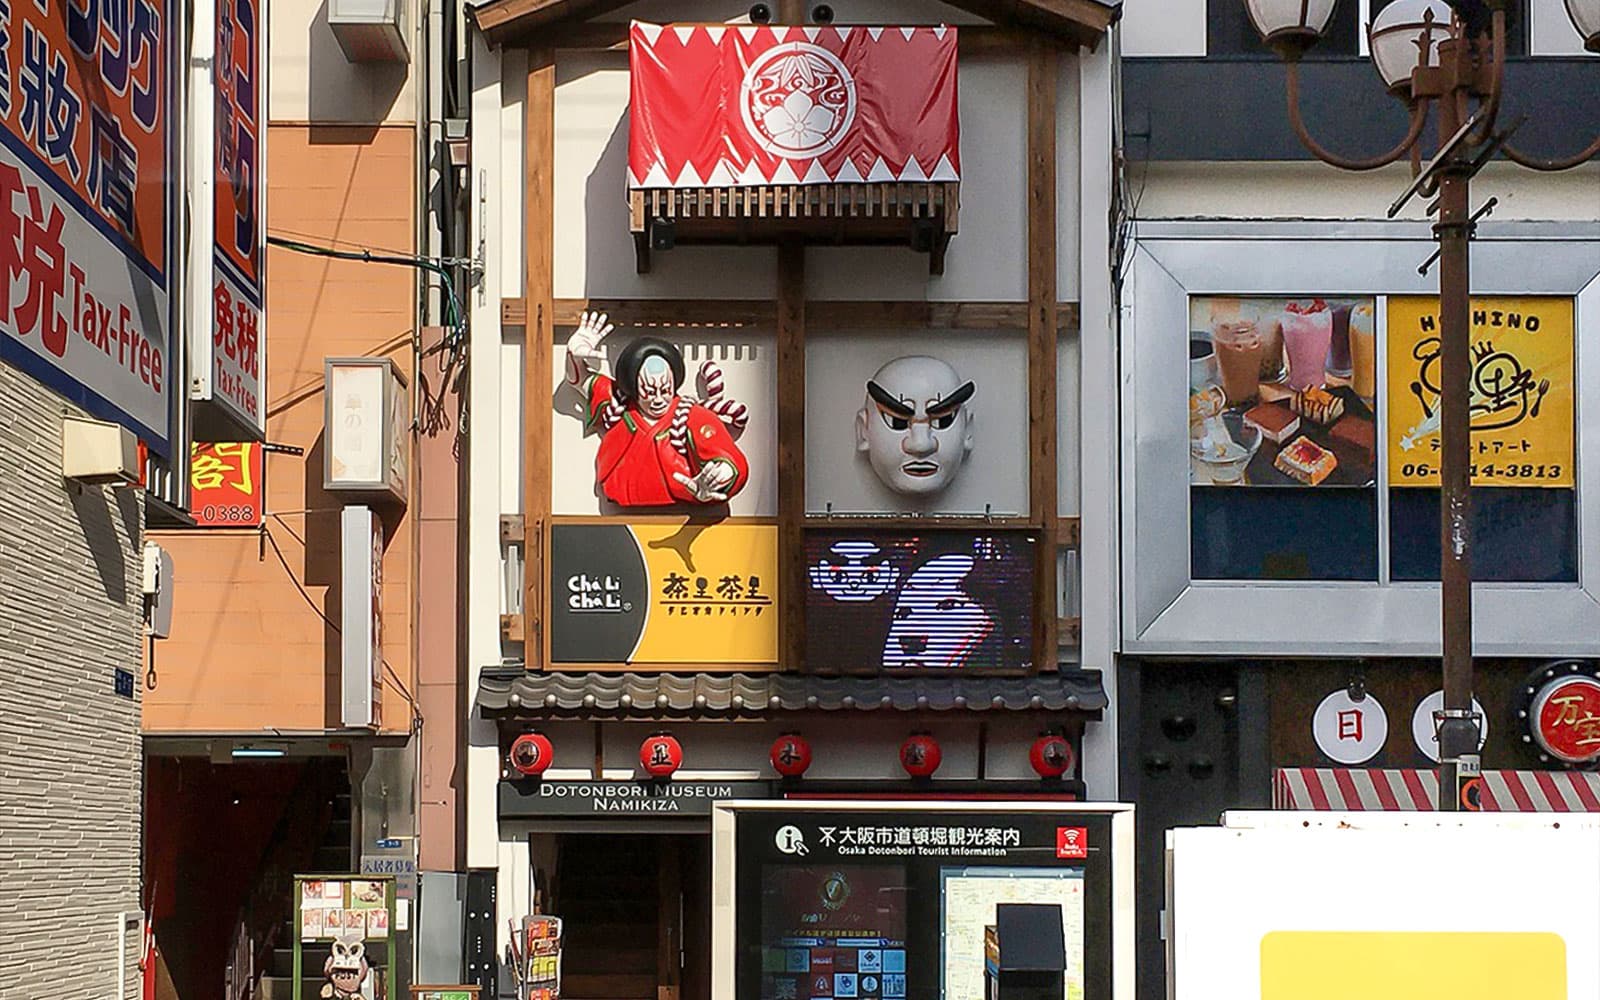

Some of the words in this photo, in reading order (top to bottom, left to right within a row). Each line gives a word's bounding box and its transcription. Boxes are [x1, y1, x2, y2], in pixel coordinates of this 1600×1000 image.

[70, 262, 163, 394] Tax-Free
[214, 279, 259, 383] 免税
[1420, 311, 1541, 333] HHINO
[216, 357, 258, 418] Tax-Free
[1402, 463, 1561, 479] 06-14-3813
[605, 576, 620, 591] Li
[662, 573, 770, 600] 茶里茶里
[605, 595, 621, 608] Li
[1337, 708, 1364, 743] 日
[540, 783, 648, 797] DOTONBORI
[655, 784, 732, 797] MUSEUM
[593, 797, 679, 812] NAMIKIZA
[838, 826, 1021, 847] 大阪市道頓堀観光案内
[838, 846, 866, 856] Osaka
[868, 846, 916, 857] Dotonbori
[918, 847, 949, 857] Tourist
[951, 847, 1007, 858] Information
